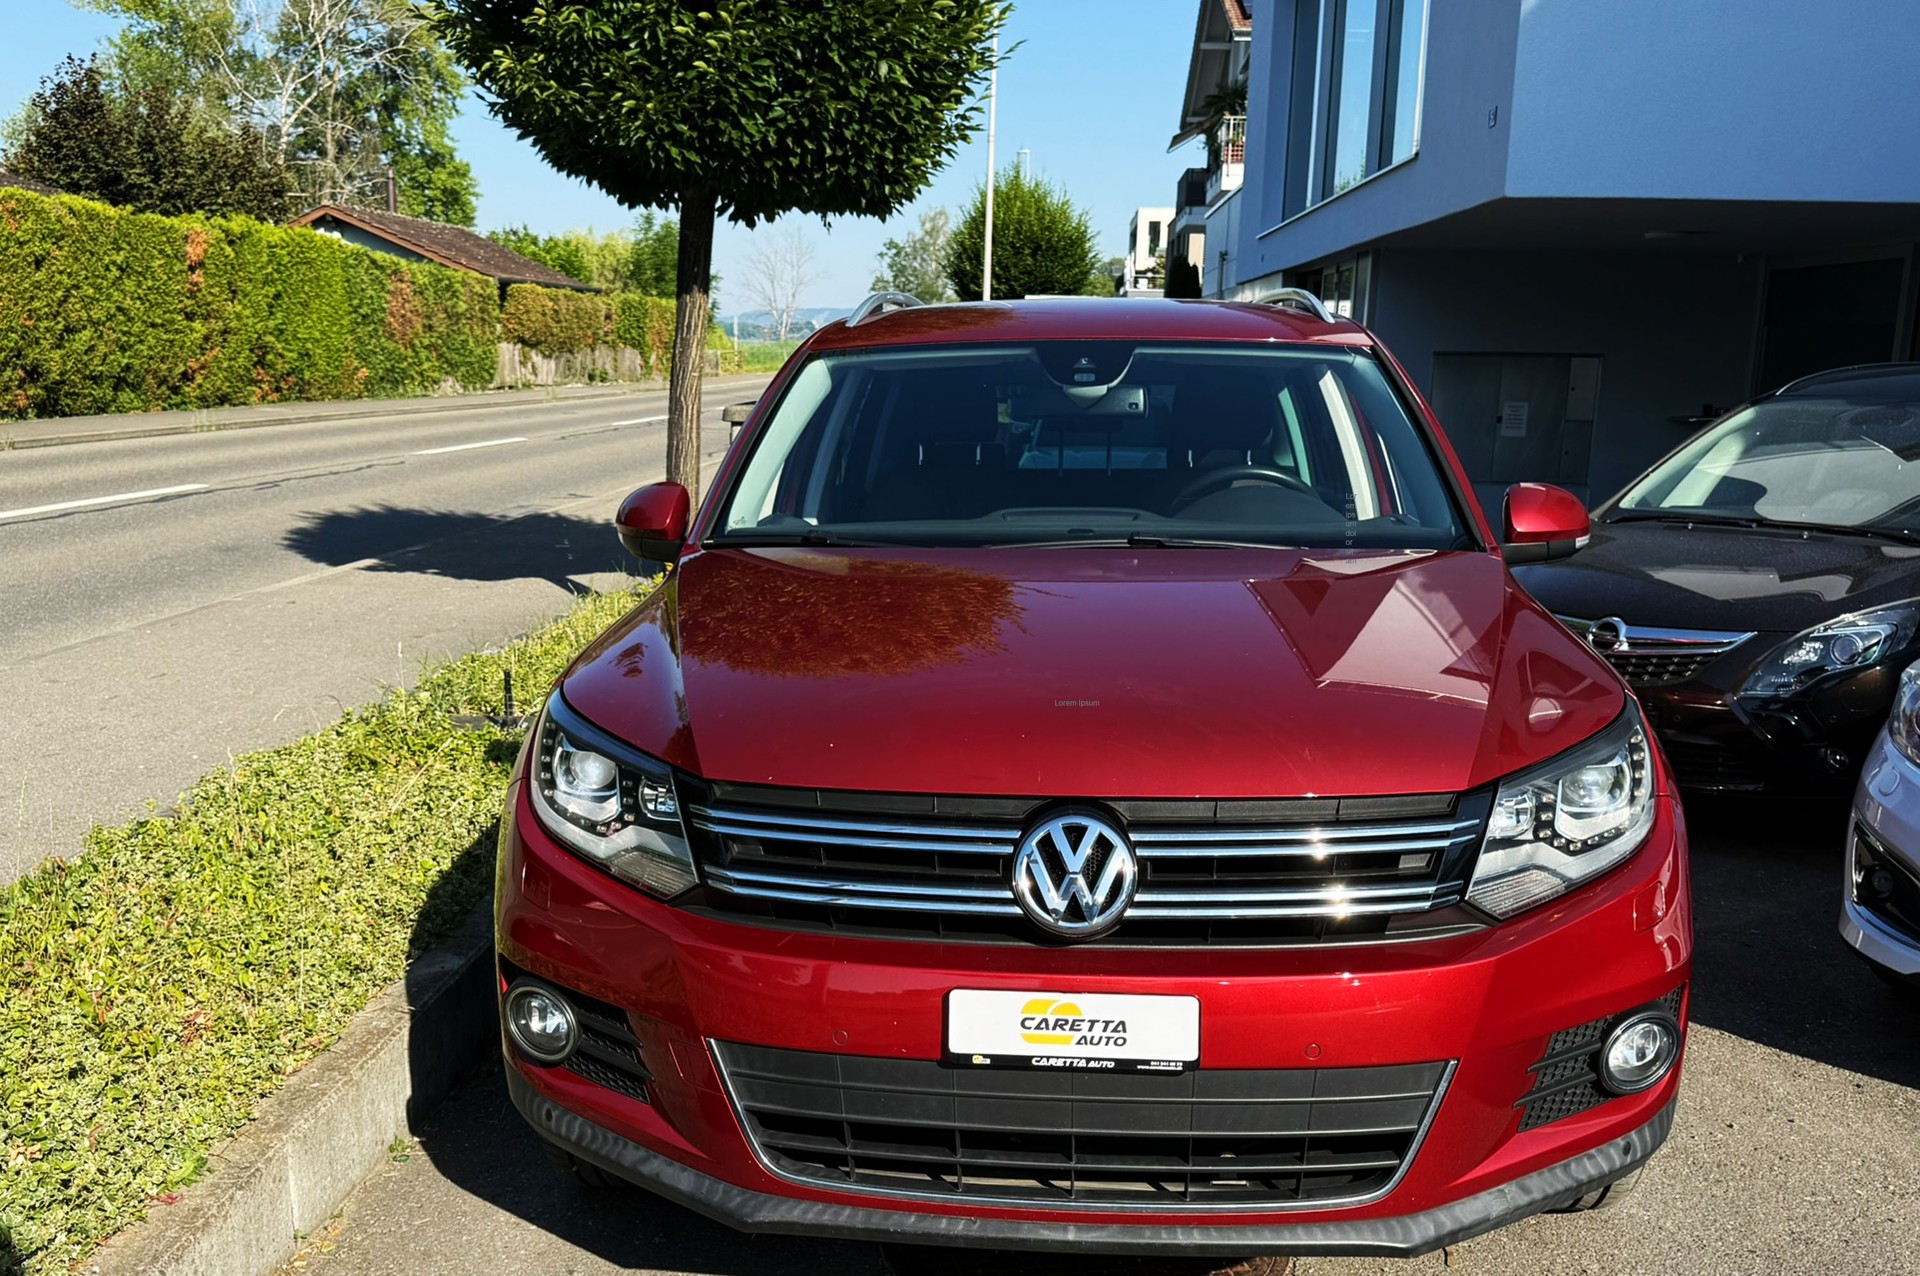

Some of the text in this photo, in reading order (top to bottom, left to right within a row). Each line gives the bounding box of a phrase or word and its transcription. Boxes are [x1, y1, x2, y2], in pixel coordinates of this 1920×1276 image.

[1020, 1017, 1127, 1033] CARETTA
[1075, 1035, 1127, 1047] AUTO
[1031, 1057, 1115, 1069] CARETTA AUTO
